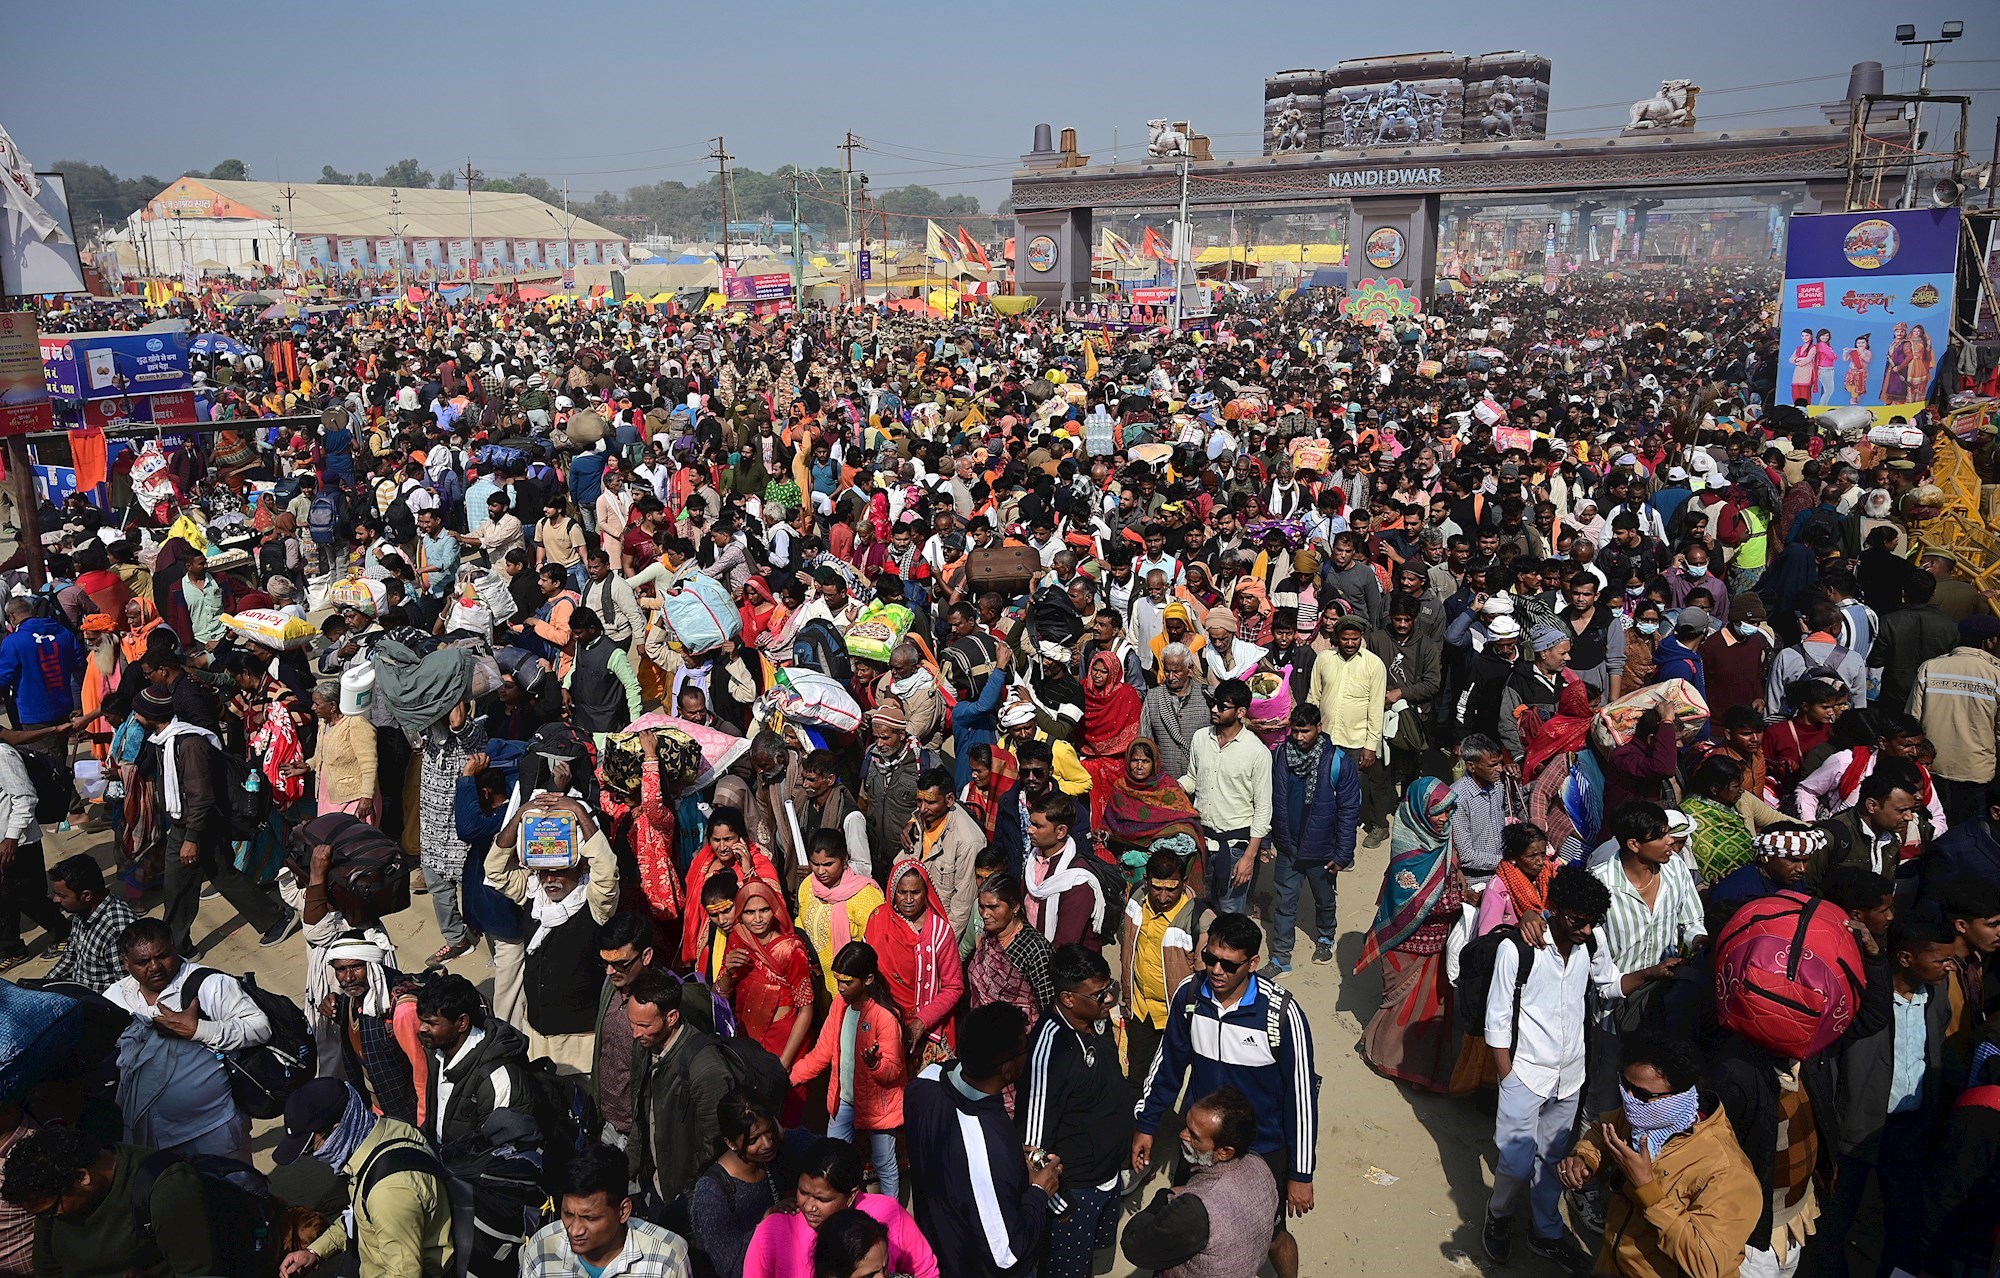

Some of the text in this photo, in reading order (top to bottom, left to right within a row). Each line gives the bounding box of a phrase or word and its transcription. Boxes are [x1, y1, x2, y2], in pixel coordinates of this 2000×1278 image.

[1328, 168, 1441, 187] NANDI DWAR
[60, 384, 75, 394] 1920
[1269, 994, 1283, 1010] IN
[1267, 1010, 1281, 1047] MOVE
